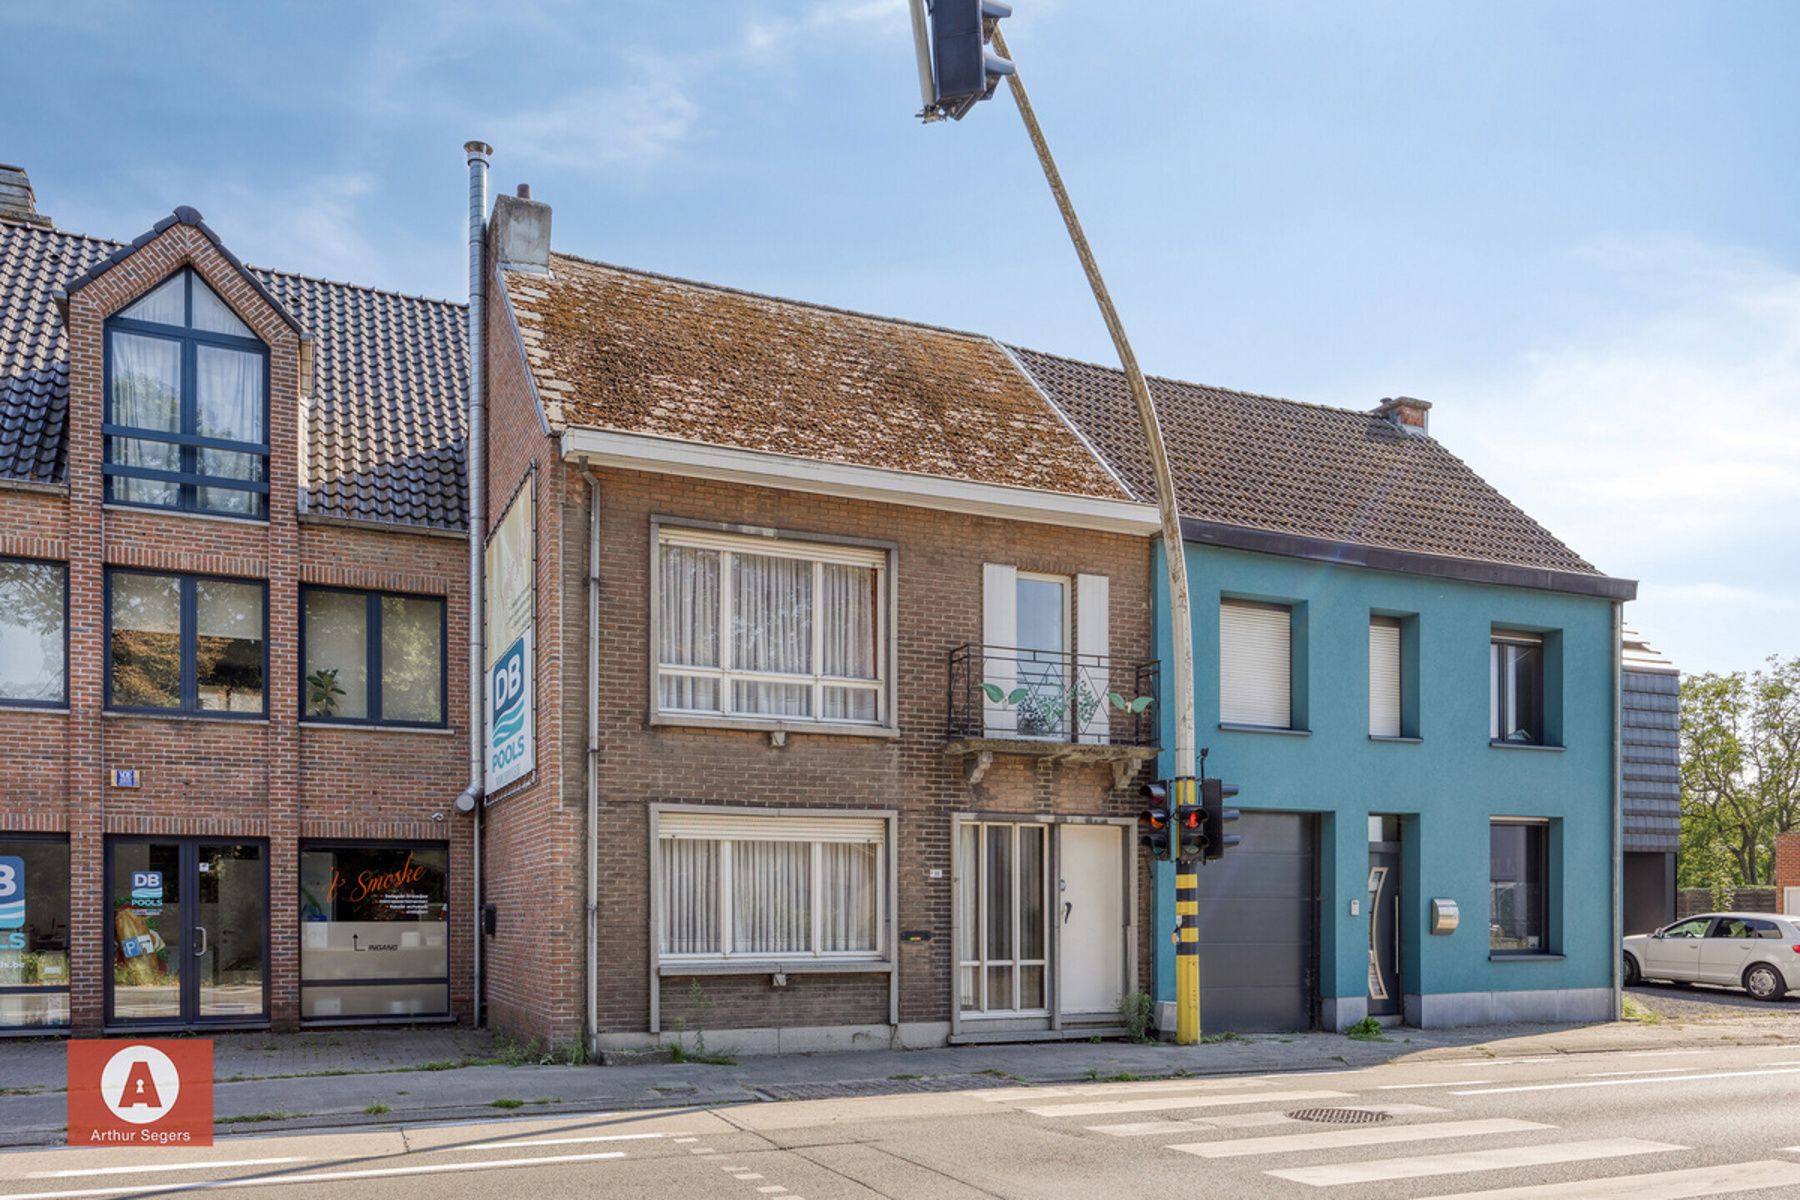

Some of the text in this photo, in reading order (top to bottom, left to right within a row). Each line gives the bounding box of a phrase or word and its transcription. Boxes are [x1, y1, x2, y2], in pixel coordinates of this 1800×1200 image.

[495, 654, 521, 711] DB
[492, 735, 525, 773] POOLS
[0, 864, 17, 896] B
[134, 873, 160, 887] DB
